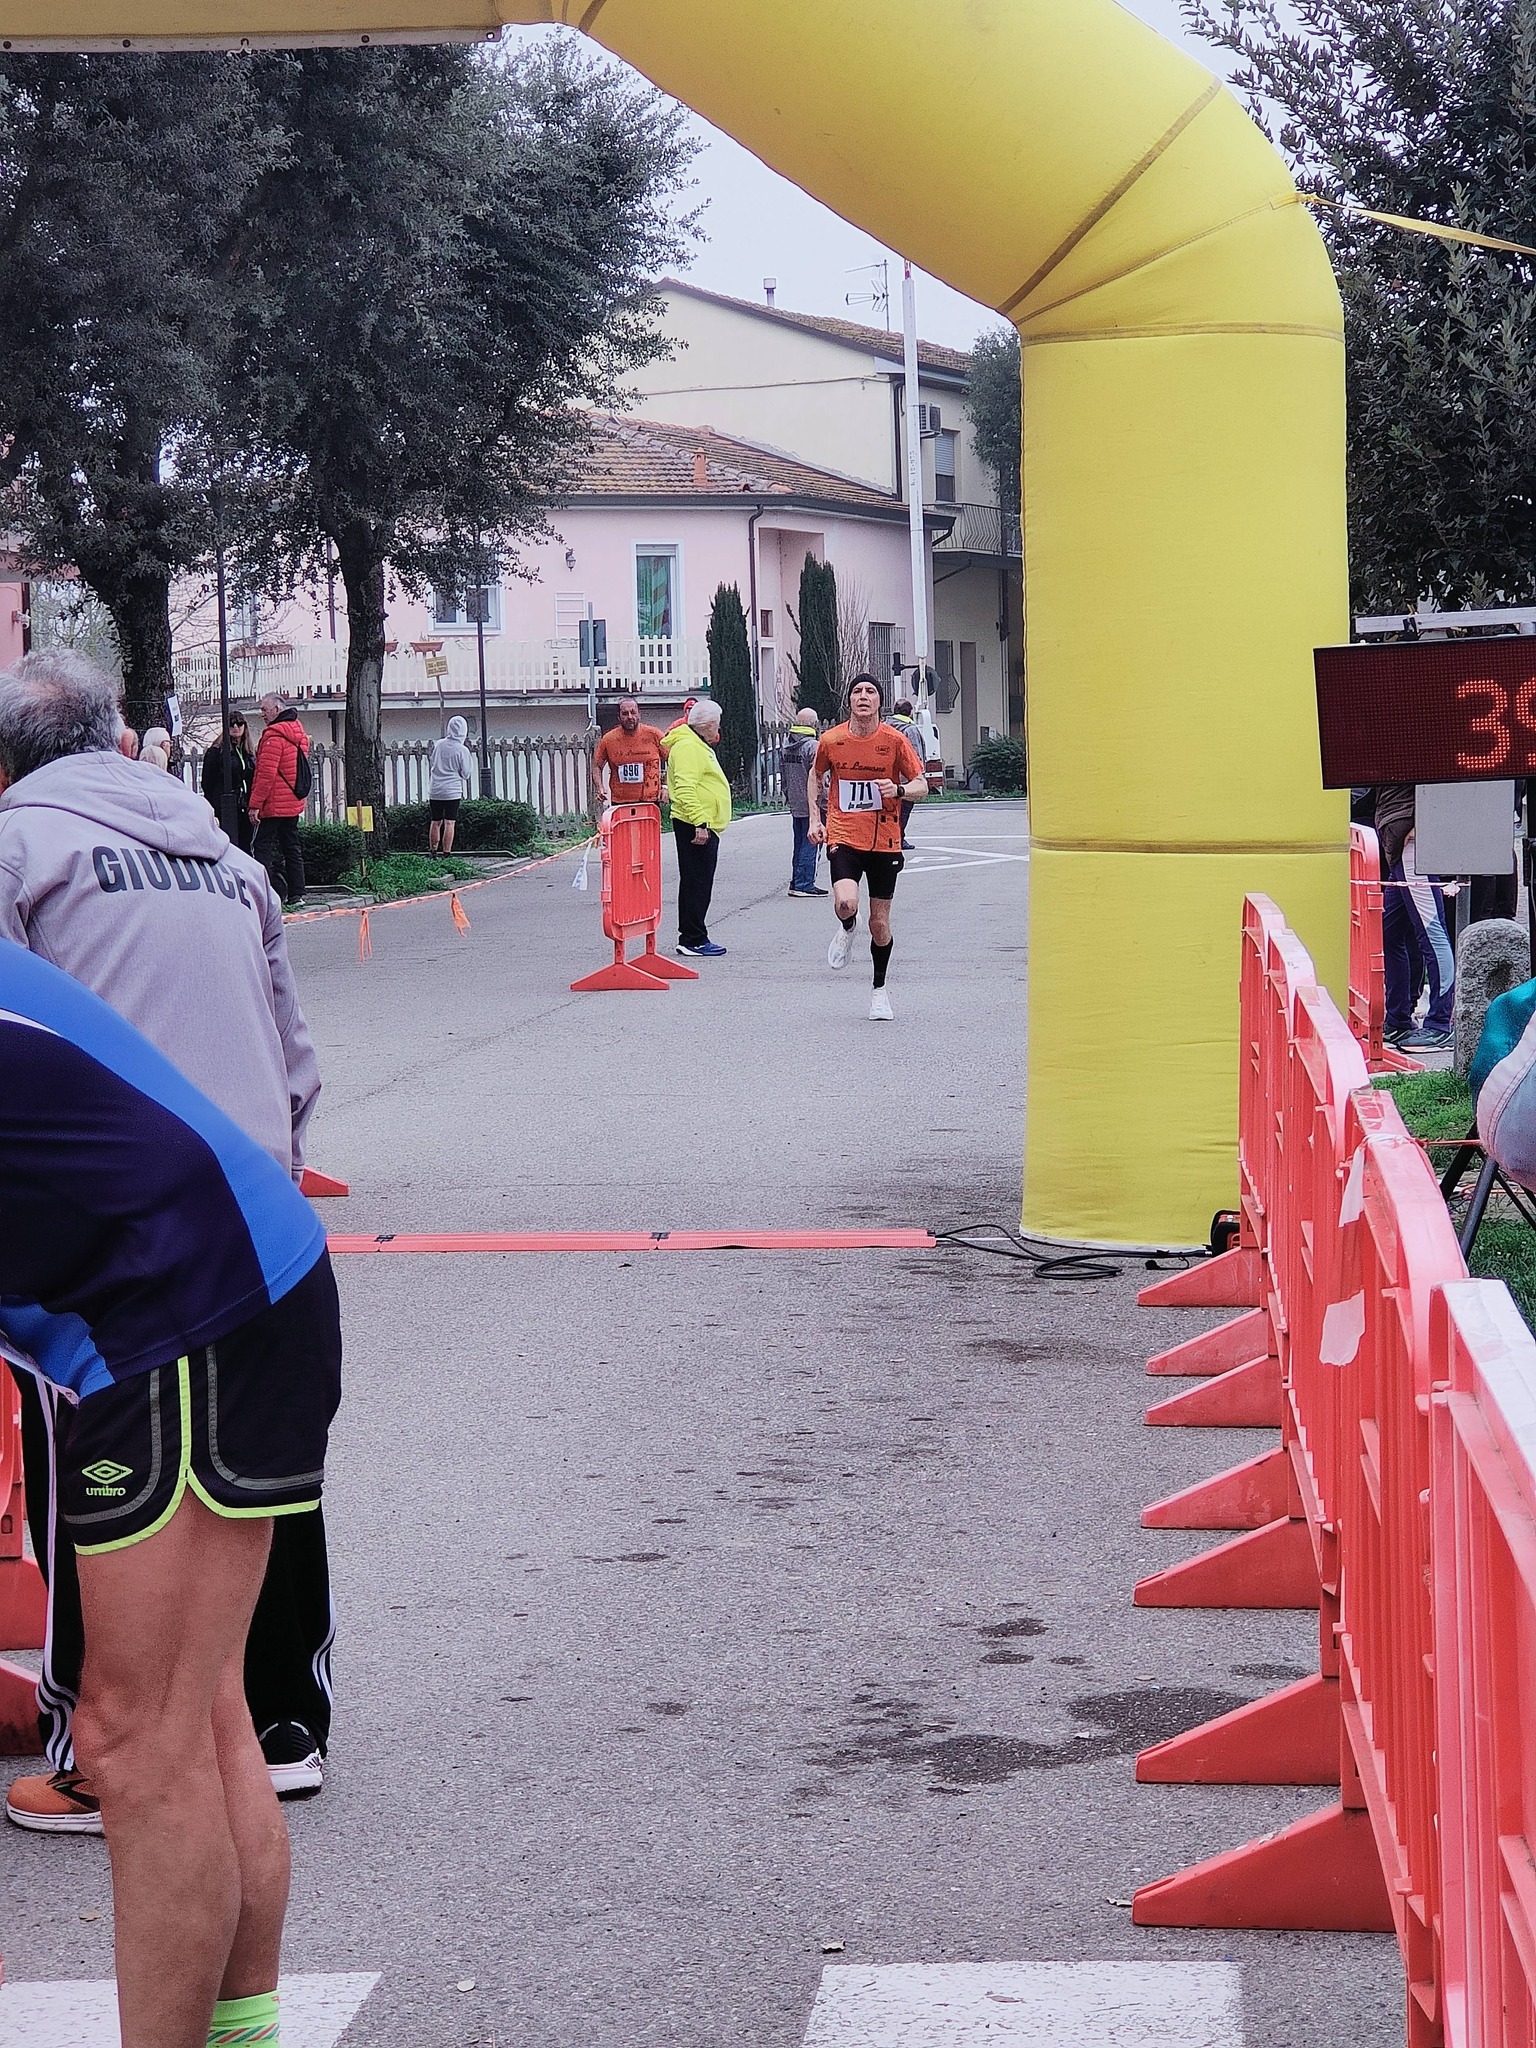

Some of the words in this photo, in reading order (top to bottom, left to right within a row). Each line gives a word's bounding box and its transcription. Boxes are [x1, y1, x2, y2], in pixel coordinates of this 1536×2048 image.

[849, 782, 873, 801] 771
[92, 846, 252, 910] GIUDICE
[86, 1486, 126, 1496] umbro
